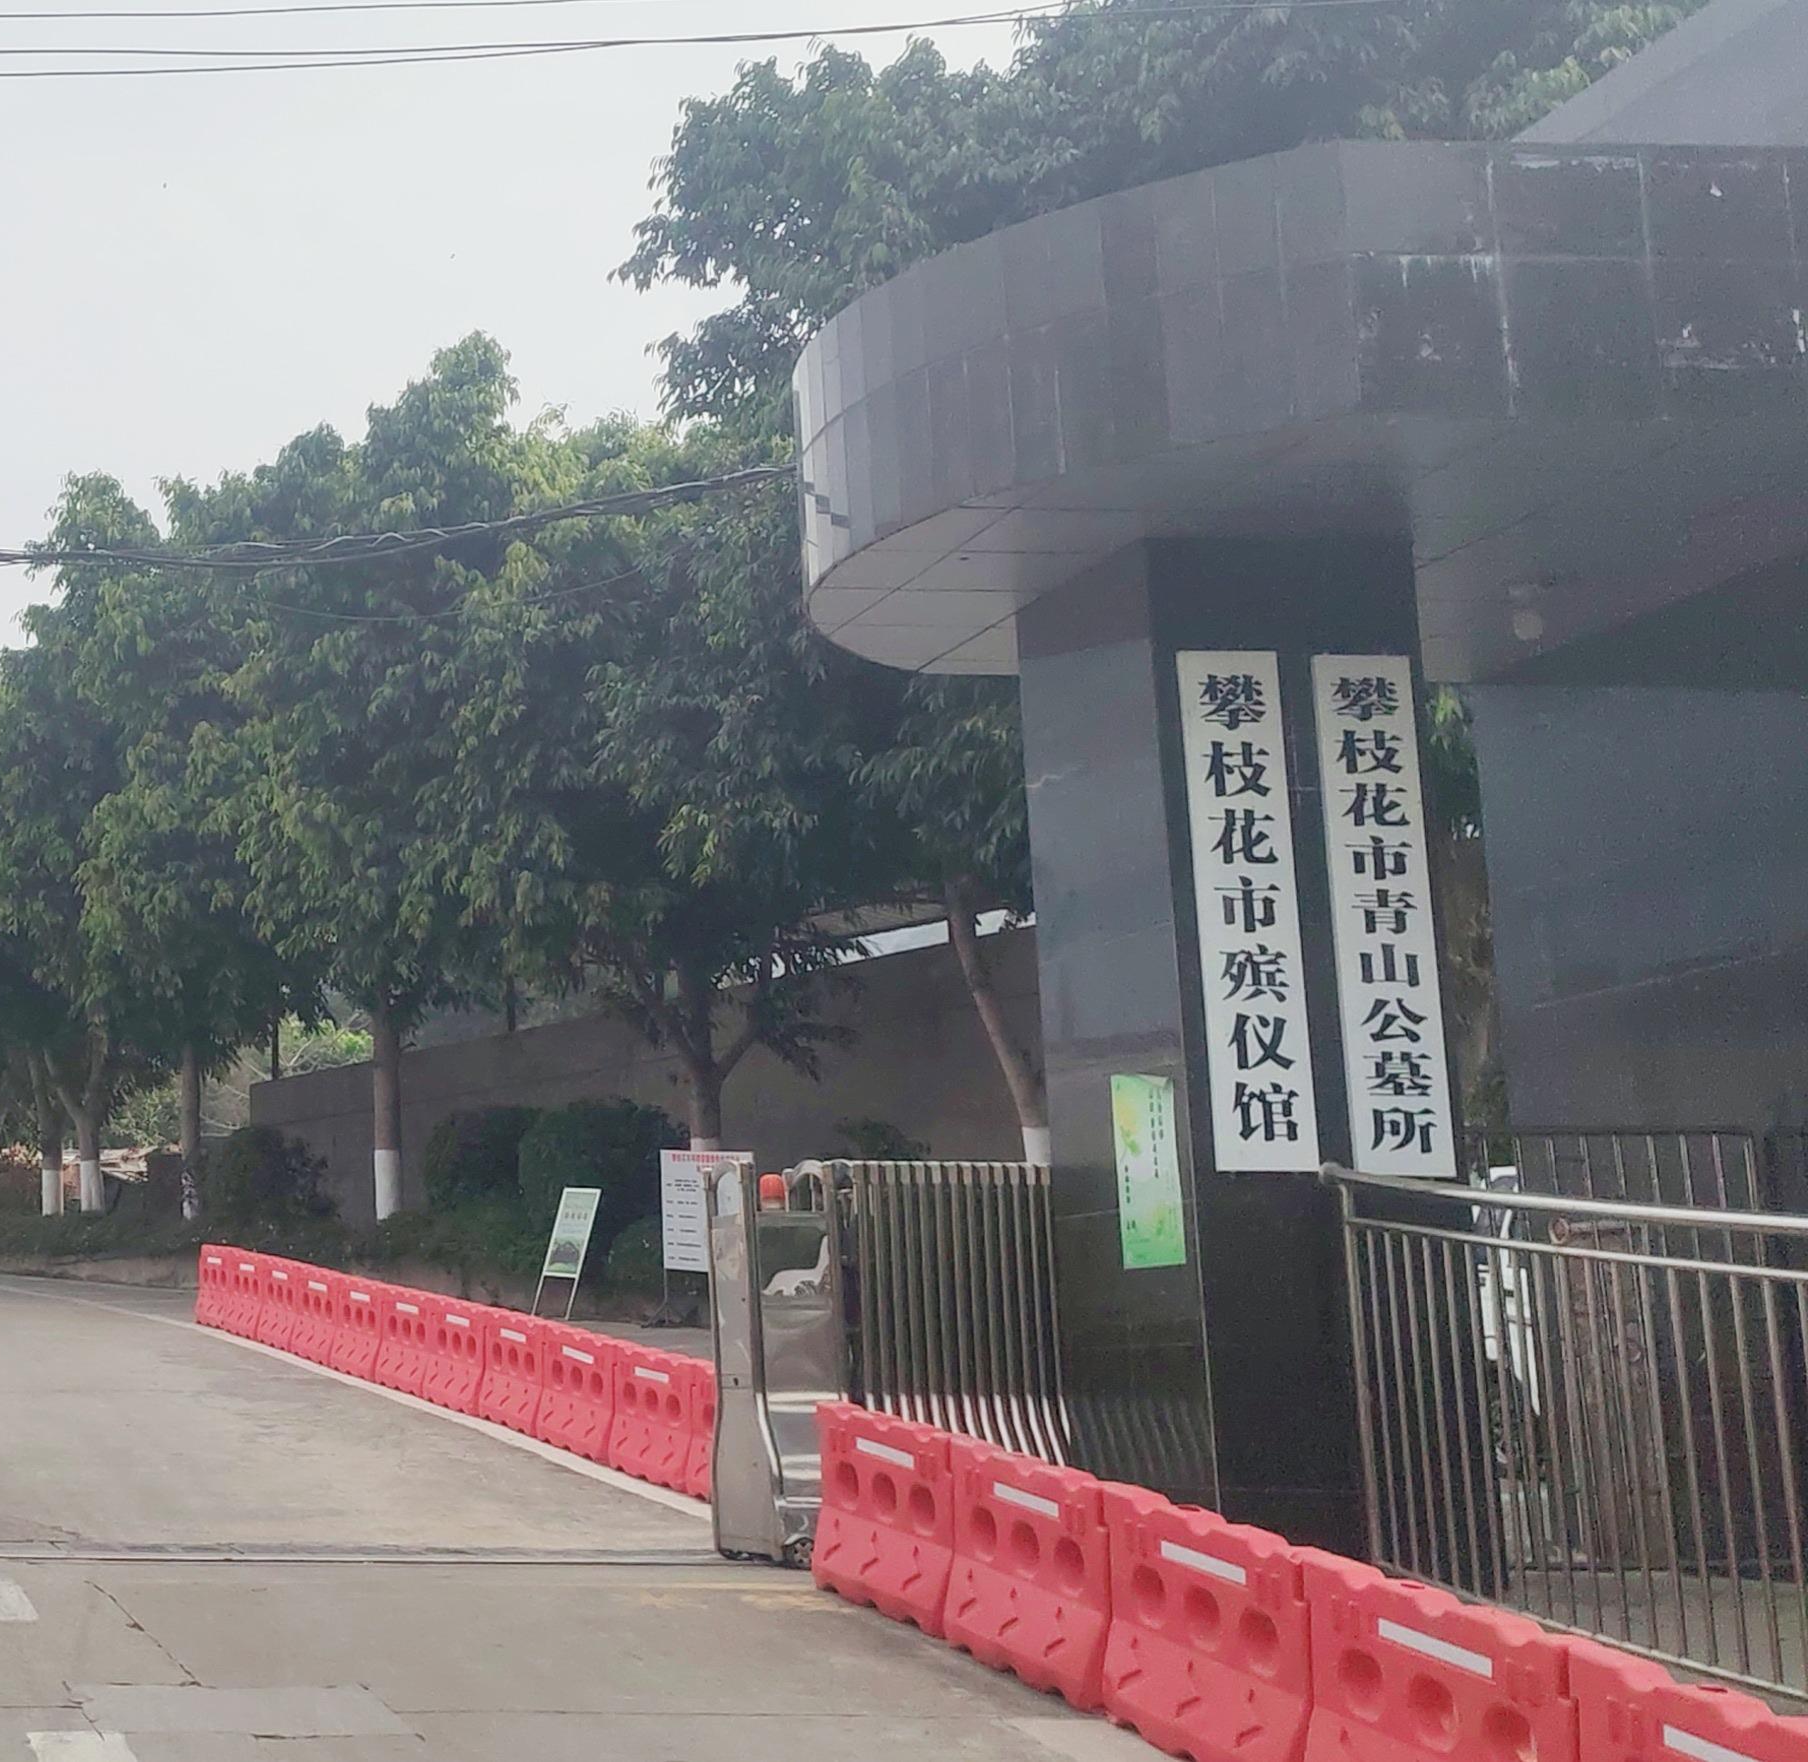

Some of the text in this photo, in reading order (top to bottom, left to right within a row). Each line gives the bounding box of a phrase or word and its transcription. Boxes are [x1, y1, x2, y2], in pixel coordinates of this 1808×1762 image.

[1198, 673, 1299, 1144] 攀枝花市殡仪馆
[1331, 676, 1438, 1155] 攀枝花市青山公墓所
